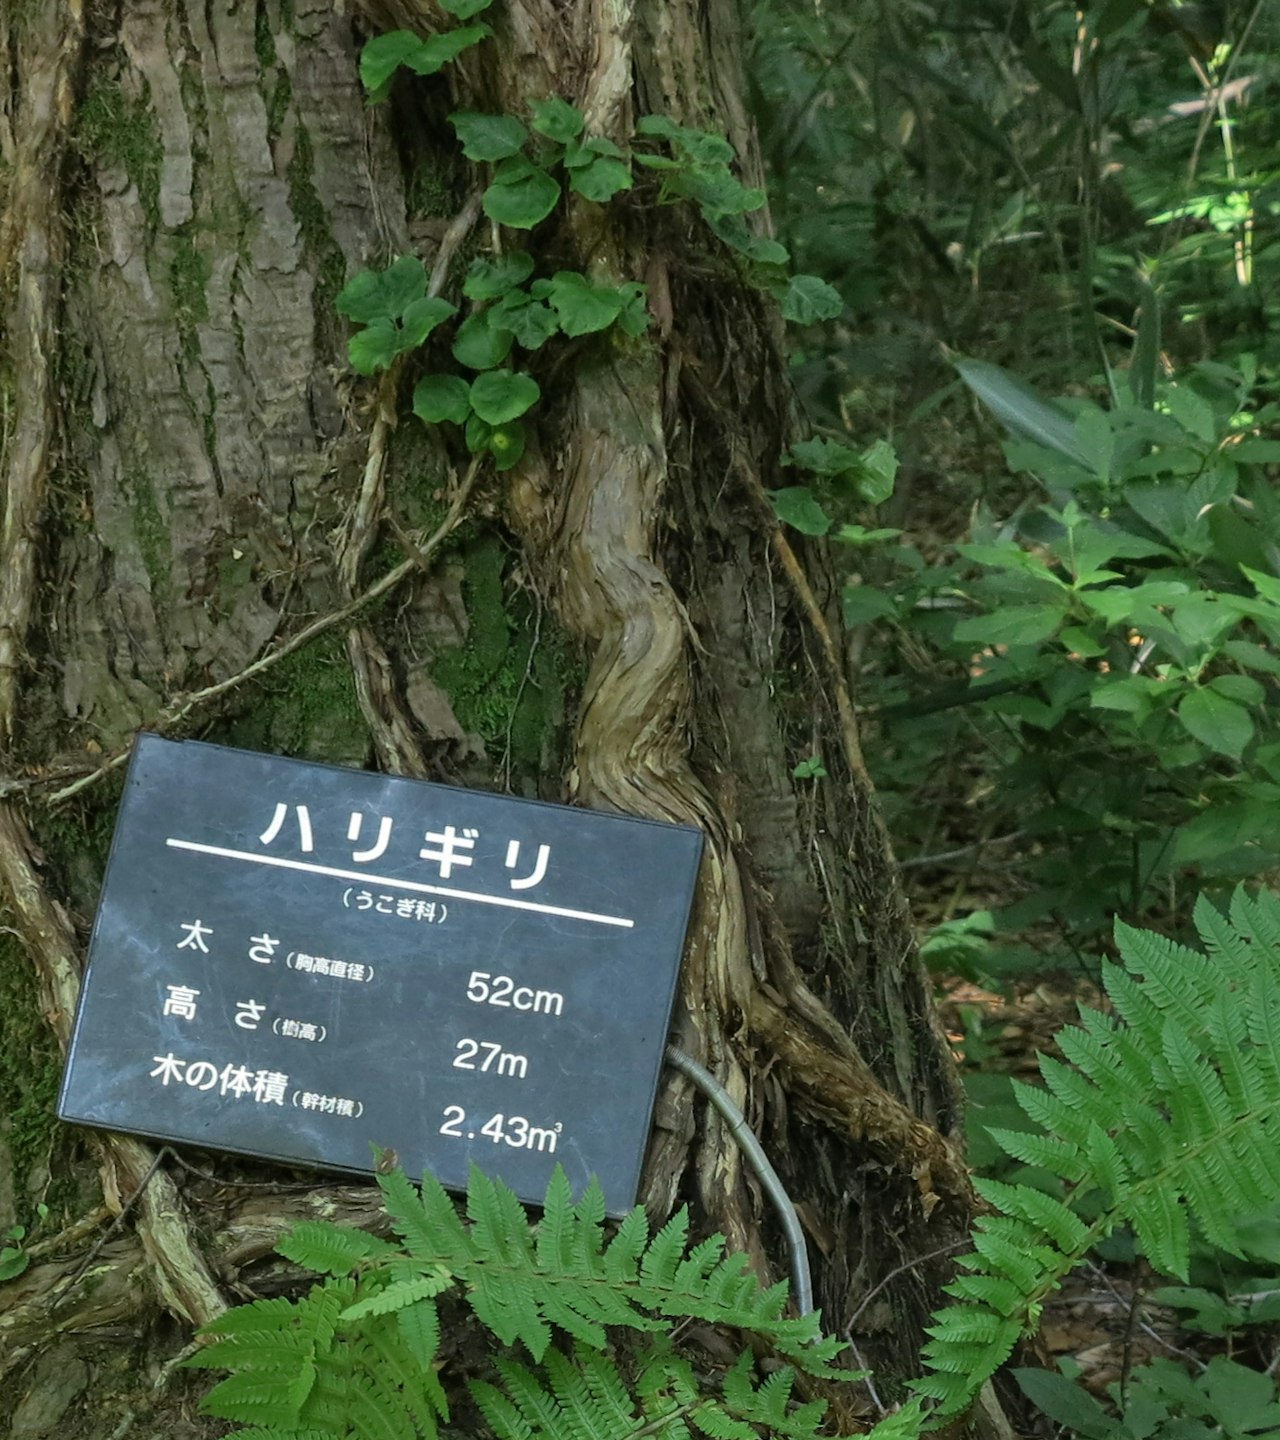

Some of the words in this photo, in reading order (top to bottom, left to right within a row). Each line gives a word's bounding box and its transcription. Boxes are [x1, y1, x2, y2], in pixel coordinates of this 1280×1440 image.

[259, 802, 551, 890] ハリギリ
[466, 971, 564, 1016] 52cm
[452, 1038, 528, 1078] 27m
